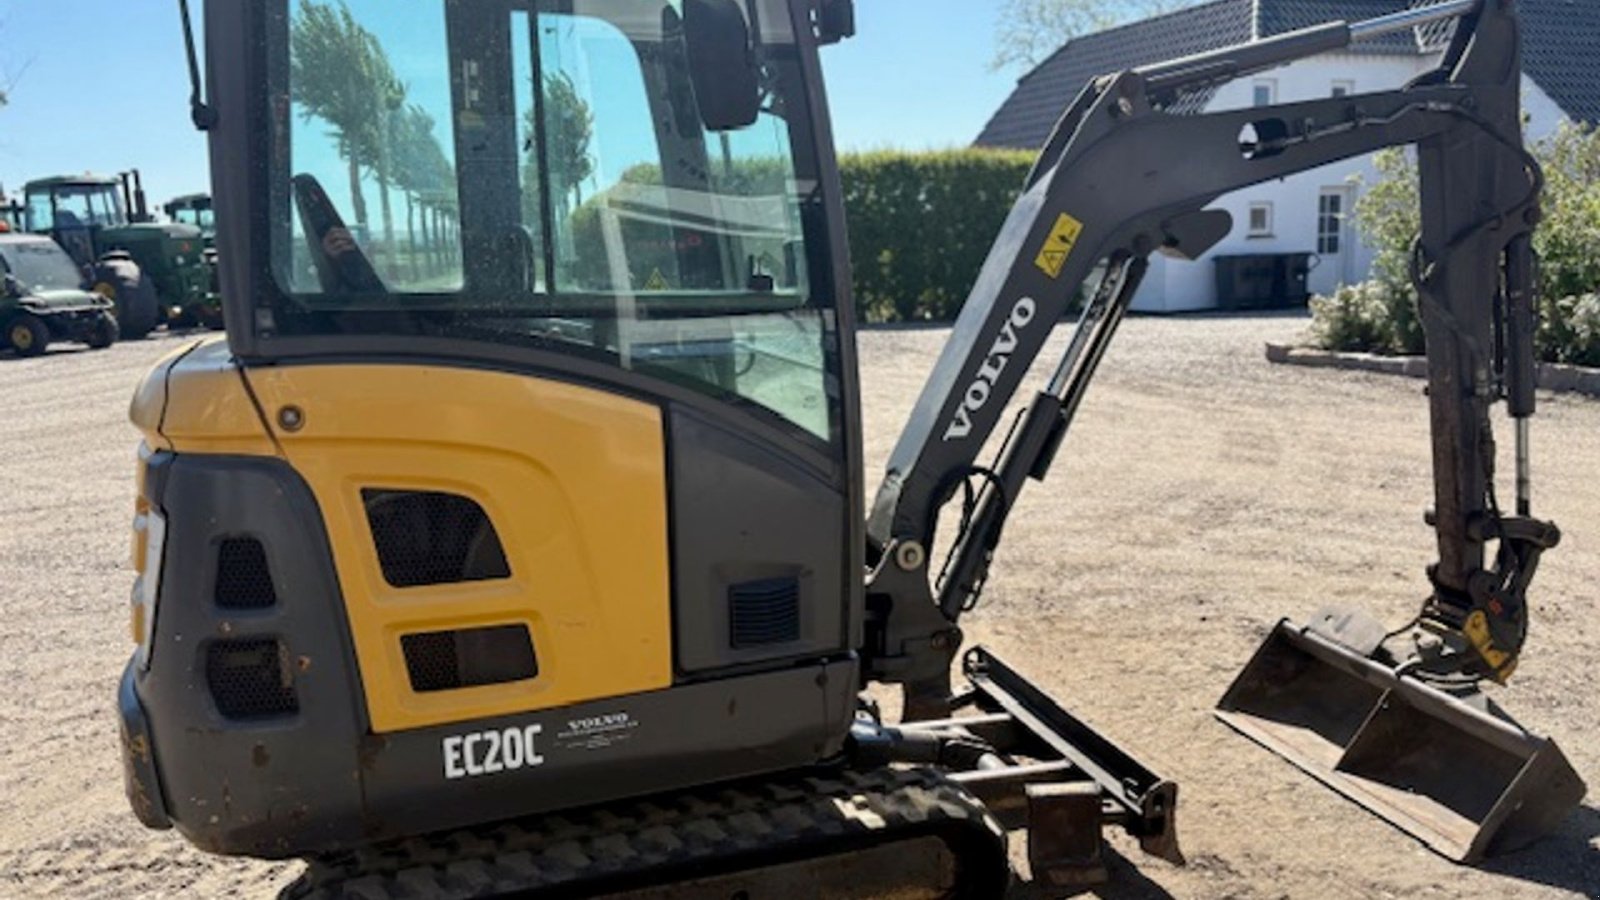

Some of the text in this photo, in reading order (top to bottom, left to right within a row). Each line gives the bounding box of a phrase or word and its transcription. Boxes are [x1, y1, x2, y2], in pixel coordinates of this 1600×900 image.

[943, 296, 1036, 441] VOLVO
[567, 712, 629, 730] VOLVO
[443, 724, 543, 778] EC20C
